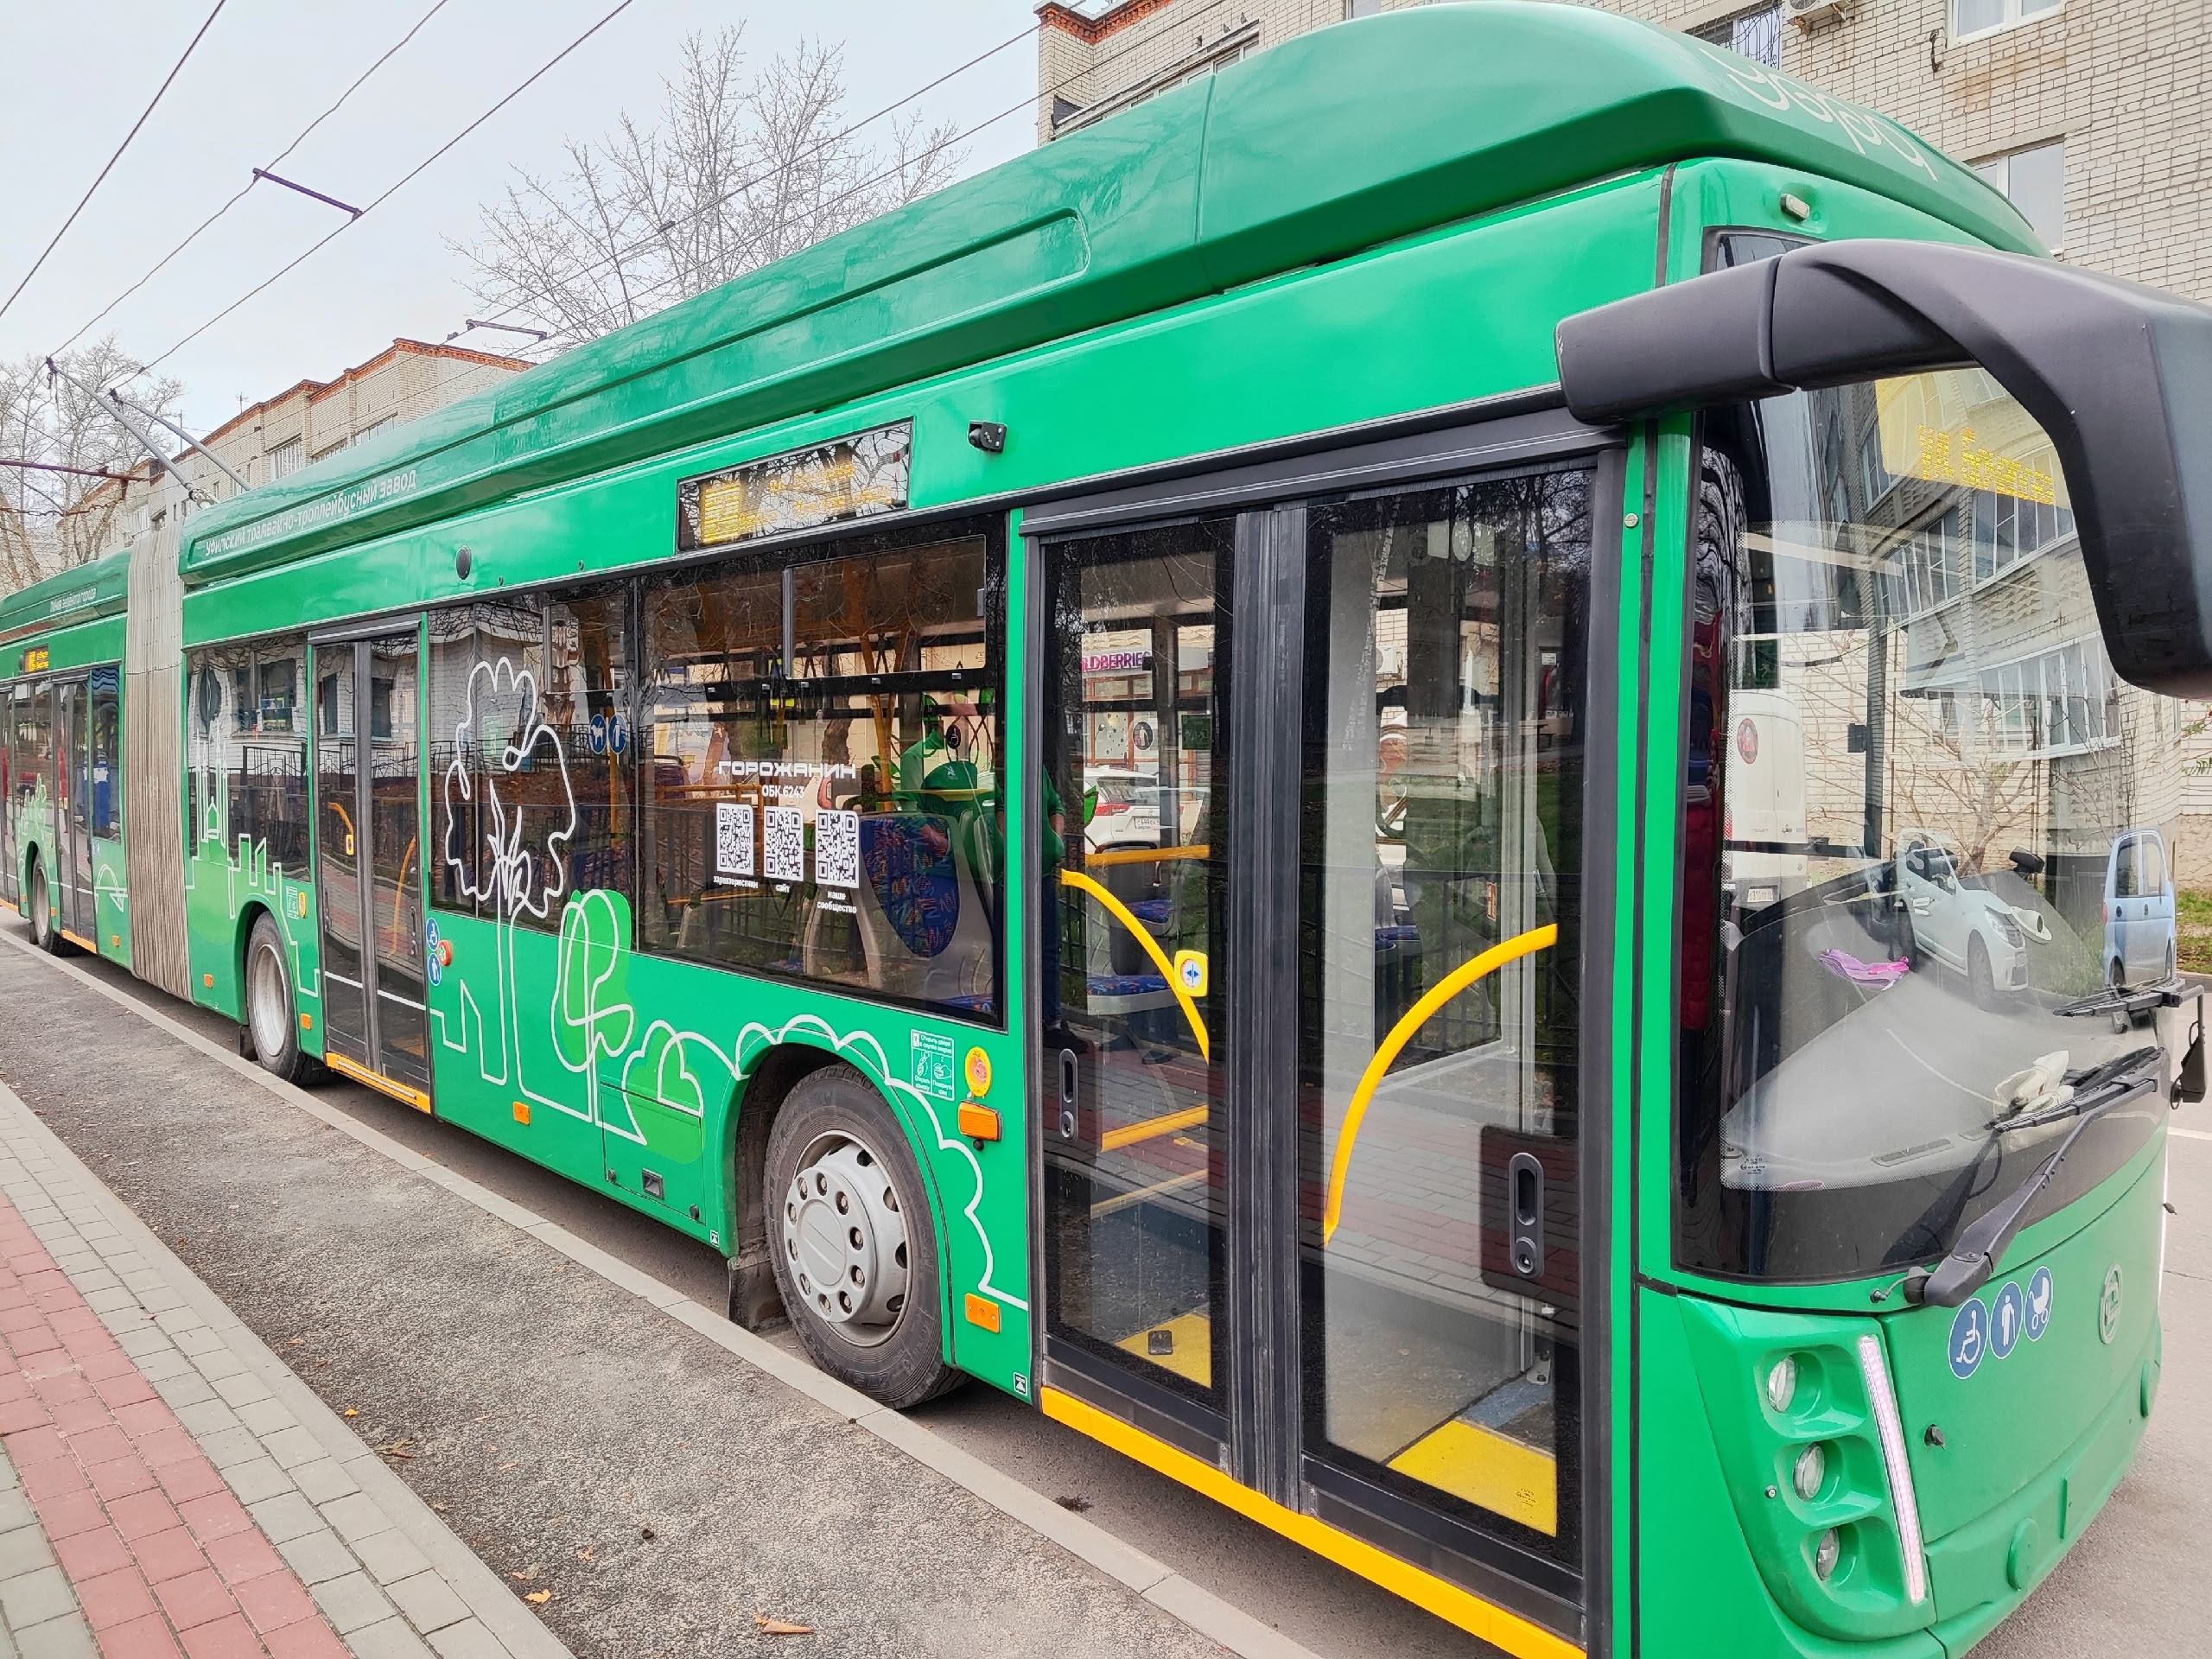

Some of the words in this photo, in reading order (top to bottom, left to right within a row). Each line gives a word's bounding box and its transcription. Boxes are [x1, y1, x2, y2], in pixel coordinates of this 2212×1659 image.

[206, 527, 245, 556] Уфимский
[247, 480, 378, 545] трамвайно-троллейбусный
[379, 469, 416, 499] завод
[718, 760, 856, 779] ГОРОЖАНИН
[761, 785, 780, 798] ОБК
[782, 785, 805, 798] 6243
[713, 875, 759, 889] характеристики
[775, 883, 791, 893] сайт
[827, 891, 847, 901] наше
[817, 901, 857, 914] сообщество
